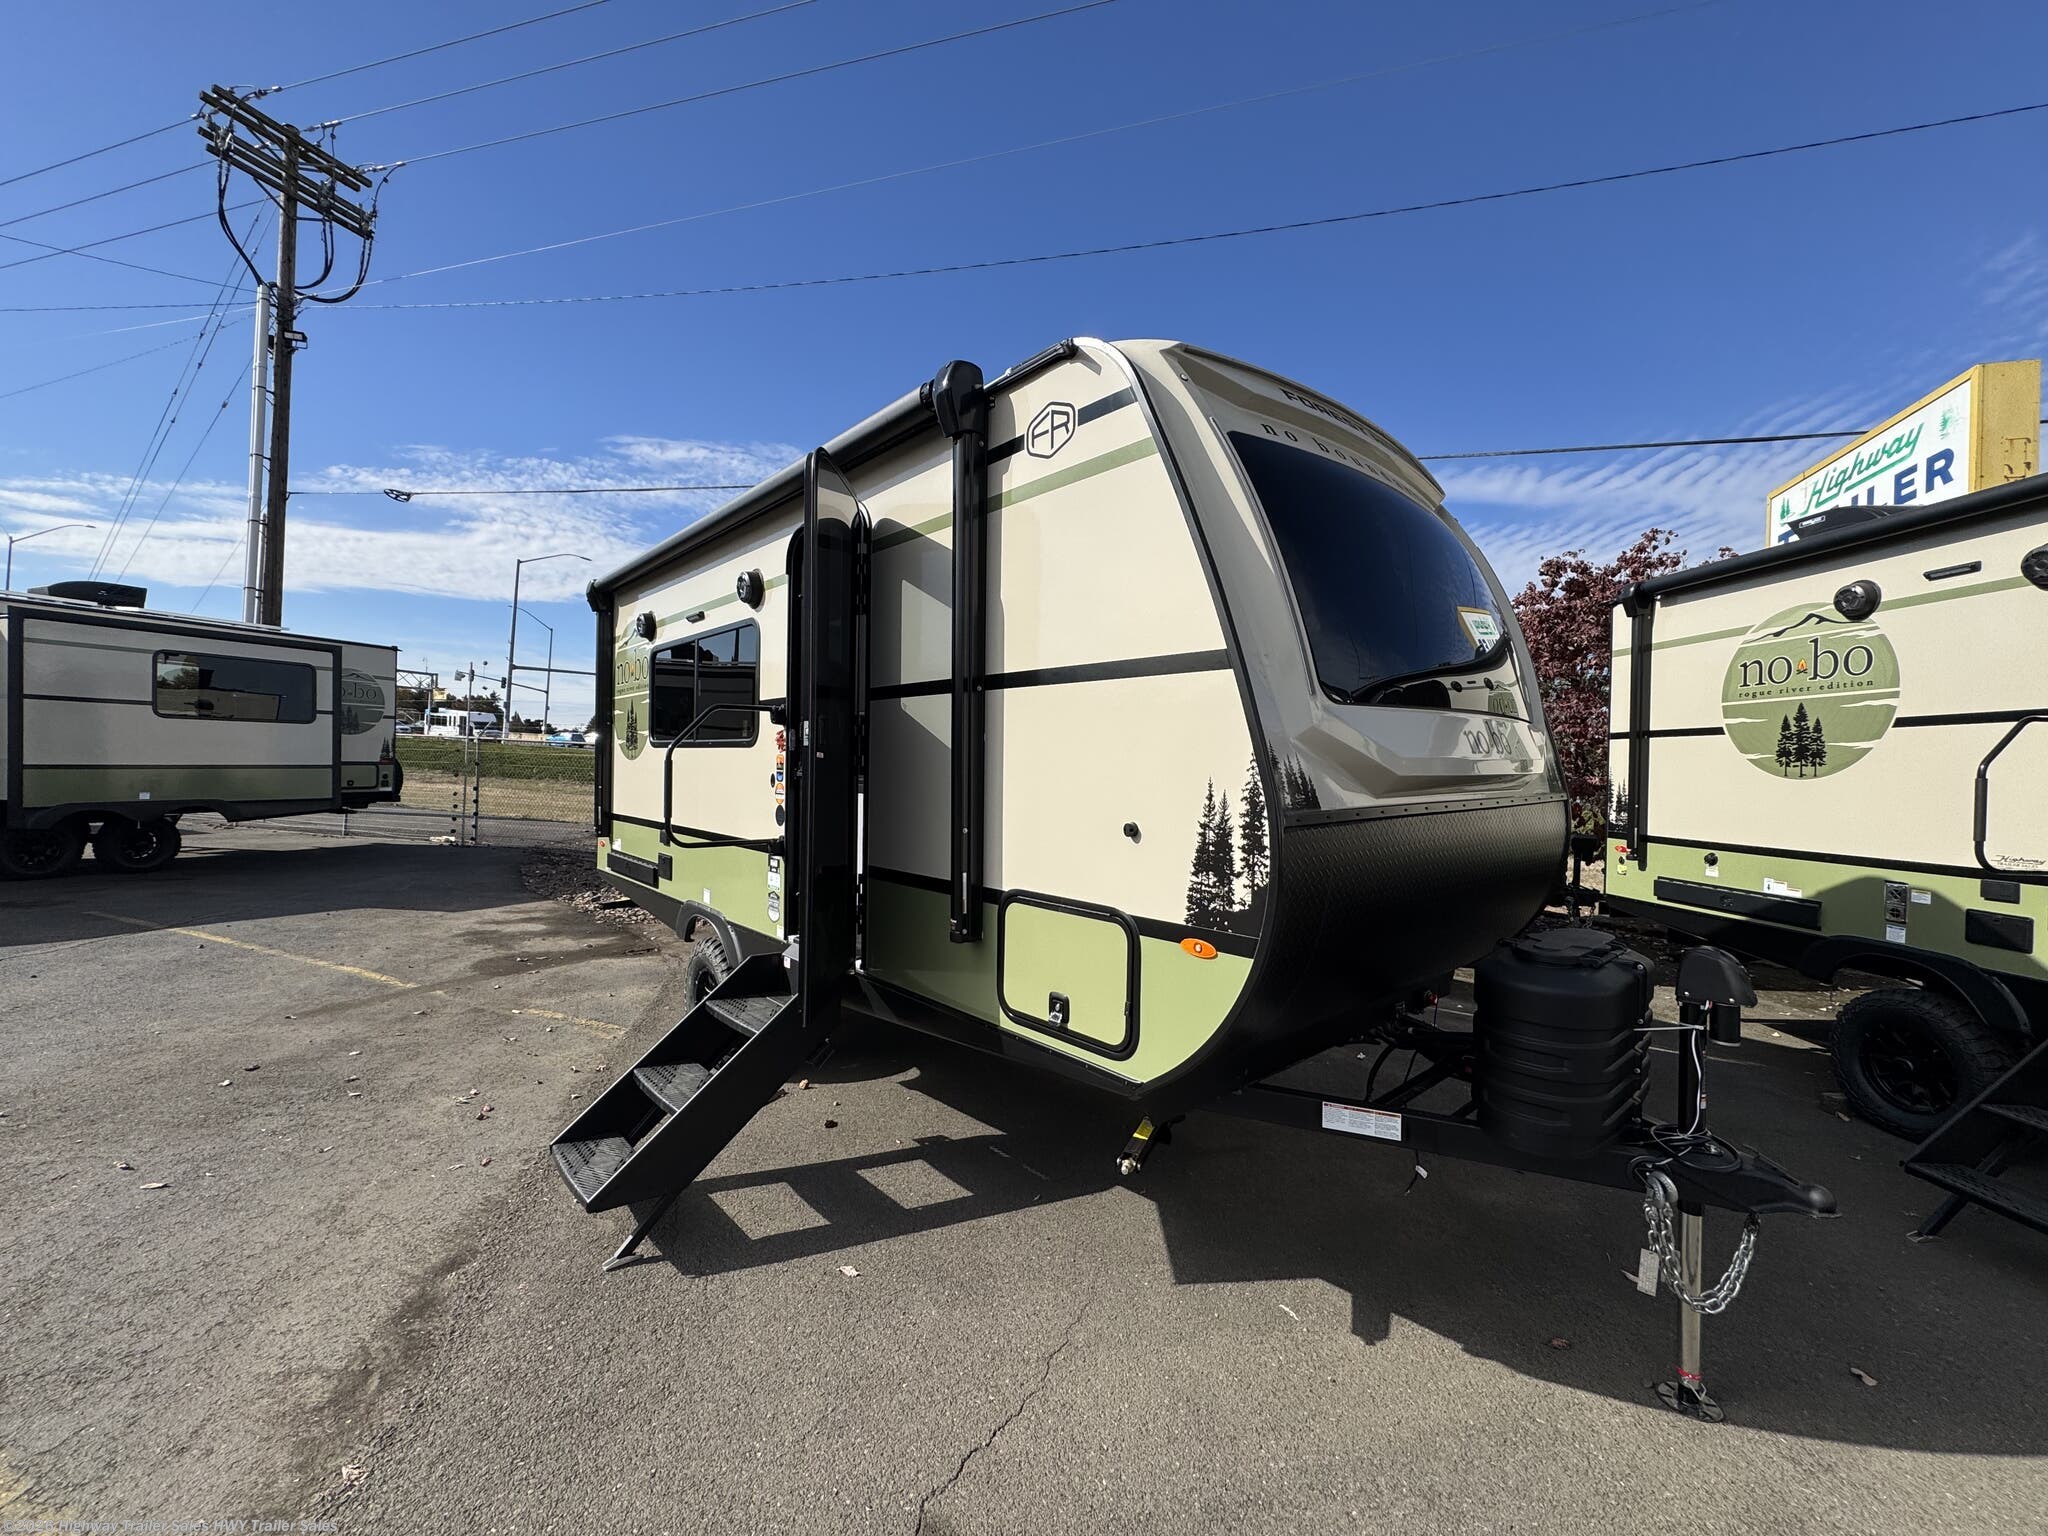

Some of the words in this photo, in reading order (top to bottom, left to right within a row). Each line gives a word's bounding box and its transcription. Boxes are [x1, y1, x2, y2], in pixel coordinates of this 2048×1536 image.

[1261, 422, 1298, 442] no
[1800, 422, 1925, 516] Highway
[1739, 690, 1772, 698] rogue
[1780, 686, 1812, 694] river
[1819, 680, 1874, 690] edition
